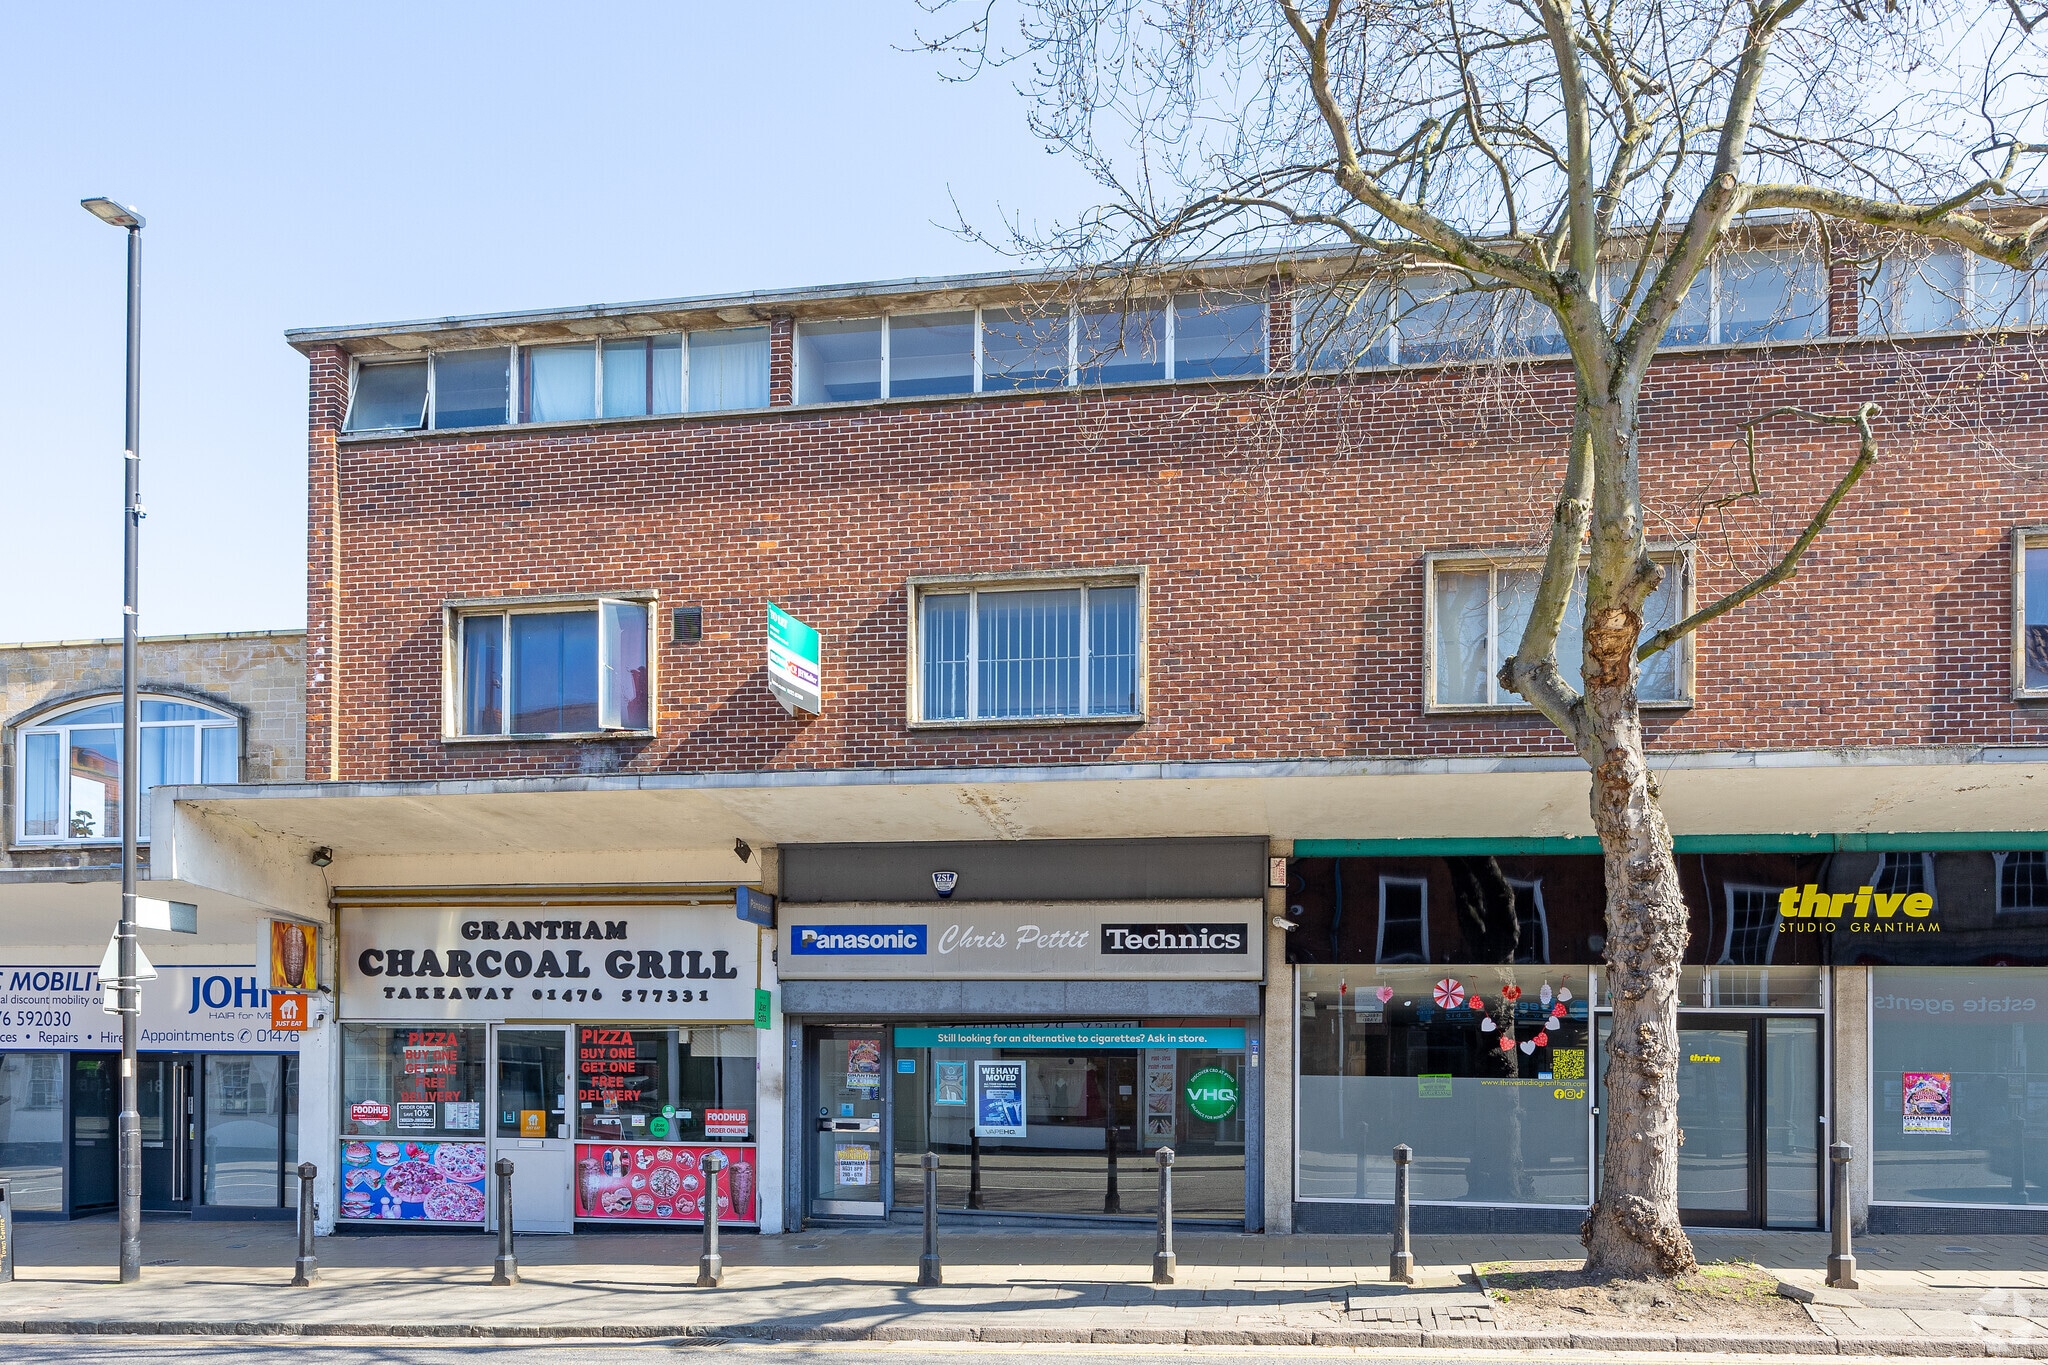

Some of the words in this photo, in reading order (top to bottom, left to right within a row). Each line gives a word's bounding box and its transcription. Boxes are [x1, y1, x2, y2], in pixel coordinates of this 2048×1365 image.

[750, 899, 771, 914] Panasonic
[1778, 884, 1934, 918] thrive
[461, 920, 627, 940] GRANTHAM
[1779, 922, 1836, 933] STUDIO
[1850, 922, 1941, 932] GRANTHAM
[802, 930, 917, 949] Panasonic
[938, 924, 1008, 954] Chris
[1016, 924, 1090, 950] Pettit
[1106, 928, 1240, 949] Technics
[358, 949, 590, 978] CHARCOAL
[605, 950, 737, 979] GRILL
[11, 995, 50, 1004] discount
[52, 995, 90, 1007] mobility
[383, 987, 514, 1000] TAKEAWAY
[532, 988, 602, 1002] 01476
[622, 989, 708, 1002] 577331
[17, 1011, 71, 1026] 592030
[39, 1031, 78, 1046] Repairs
[141, 1029, 234, 1043] Appointments
[408, 1032, 458, 1046] PIZZA
[582, 1029, 633, 1045] PIZZA
[938, 1034, 956, 1042] Still
[958, 1034, 991, 1044] looking
[993, 1034, 1007, 1042] for
[1023, 1034, 1075, 1042] alternative
[1091, 1034, 1144, 1045] cigarettes?
[1147, 1034, 1165, 1042] Ask
[1168, 1034, 1176, 1042] in
[405, 1050, 429, 1059] BUY
[433, 1050, 457, 1060] ONE
[581, 1048, 606, 1058] BUY
[609, 1048, 636, 1058] ONE
[405, 1064, 429, 1074] GET
[432, 1064, 457, 1074] ONE
[581, 1062, 606, 1072] GET
[609, 1062, 636, 1072] ONE
[416, 1078, 446, 1088] FREE
[592, 1076, 624, 1087] FREE
[401, 1091, 461, 1102] DELIVERY
[579, 1090, 641, 1101] DELIVERY
[1187, 1088, 1237, 1102] VHQ
[353, 1106, 388, 1114] FOODHUB
